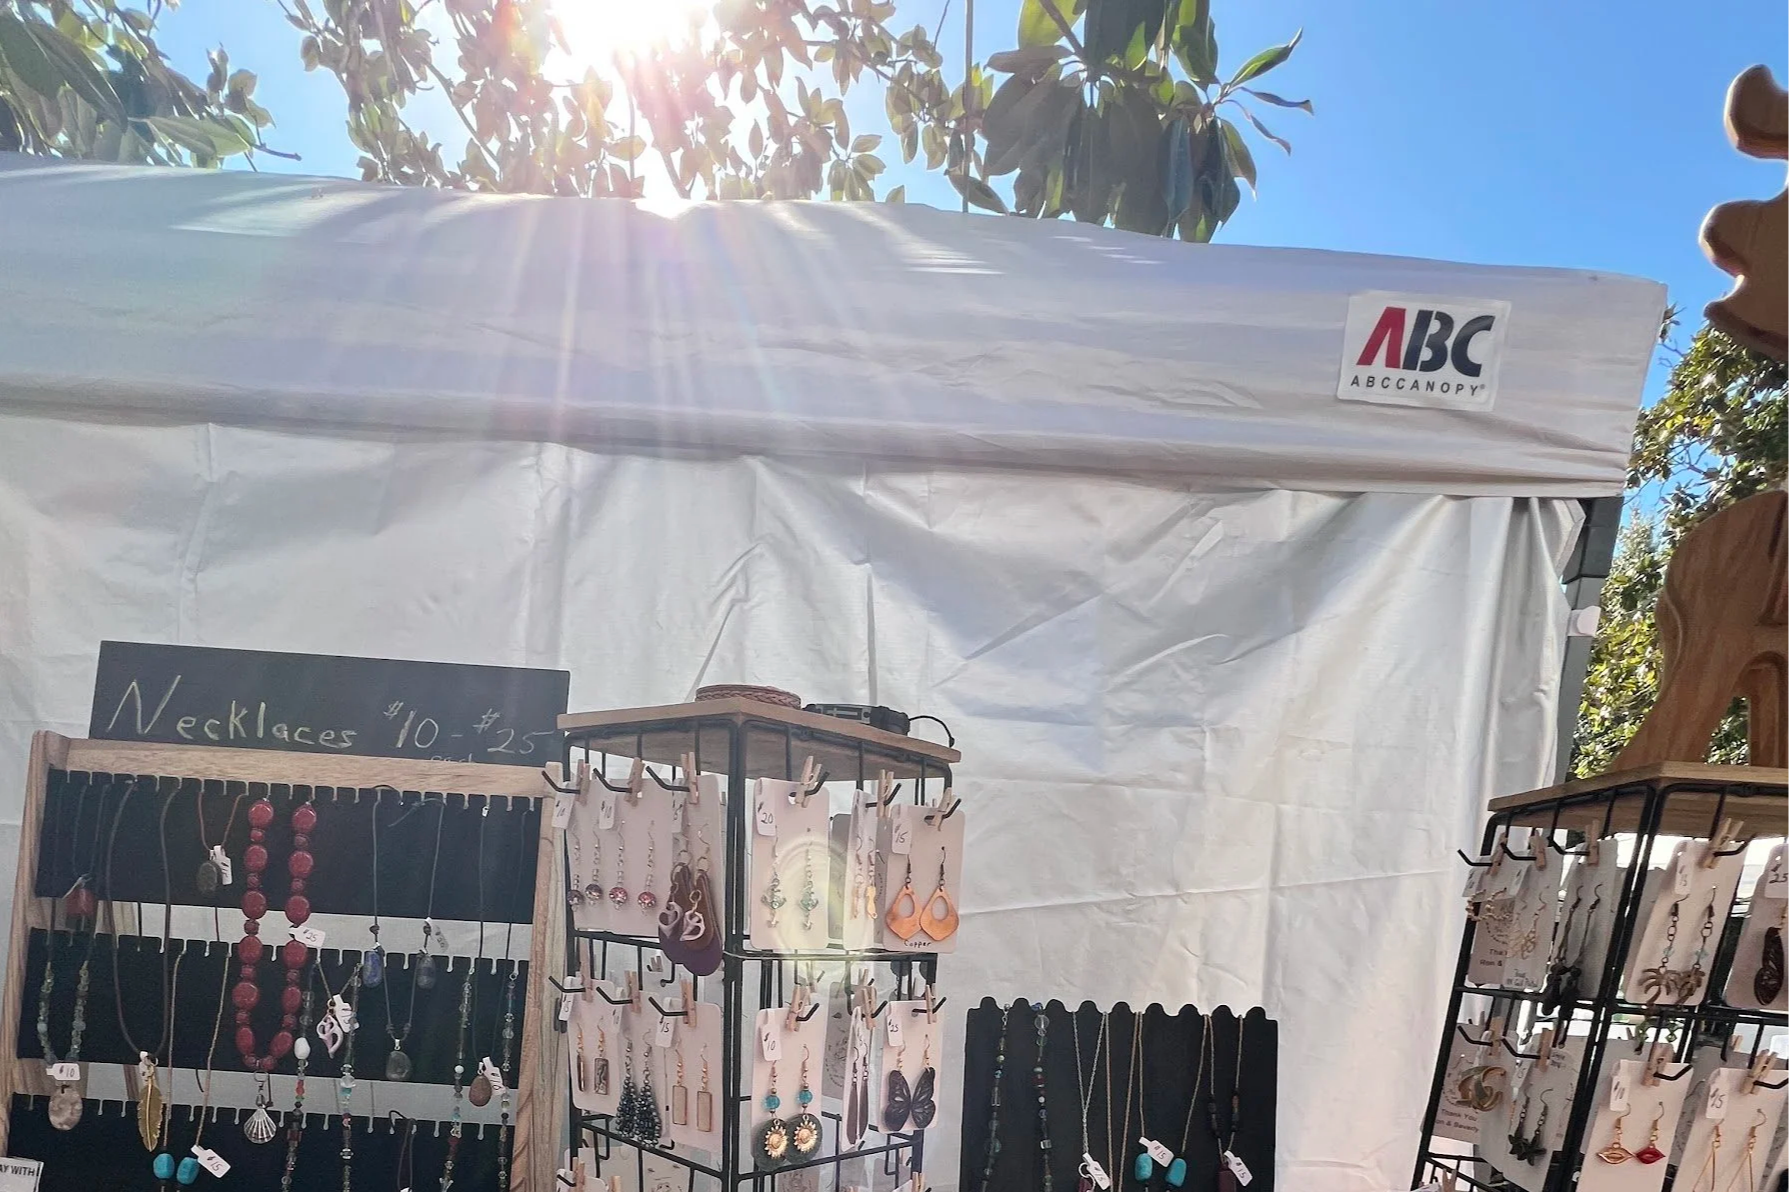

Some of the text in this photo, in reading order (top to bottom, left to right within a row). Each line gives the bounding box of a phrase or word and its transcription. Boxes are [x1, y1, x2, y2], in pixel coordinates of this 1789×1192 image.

[1355, 306, 1496, 378] ABC
[1350, 375, 1479, 397] ABCCANOPY
[106, 674, 357, 749] Necklaces
[382, 700, 439, 748] $10
[757, 800, 774, 825] $20
[893, 823, 906, 844] $15
[1769, 863, 1789, 884] $25
[302, 928, 318, 943] $25
[903, 939, 932, 949] Copper
[658, 1014, 671, 1034] $15
[887, 1018, 900, 1033] $25
[763, 1032, 777, 1051] $10
[58, 1064, 75, 1077] $10
[1709, 1087, 1726, 1110] $15
[1153, 1144, 1167, 1161] $15
[10, 1165, 35, 1177] WITH
[206, 1155, 221, 1172] $15
[1235, 1161, 1247, 1179] $15
